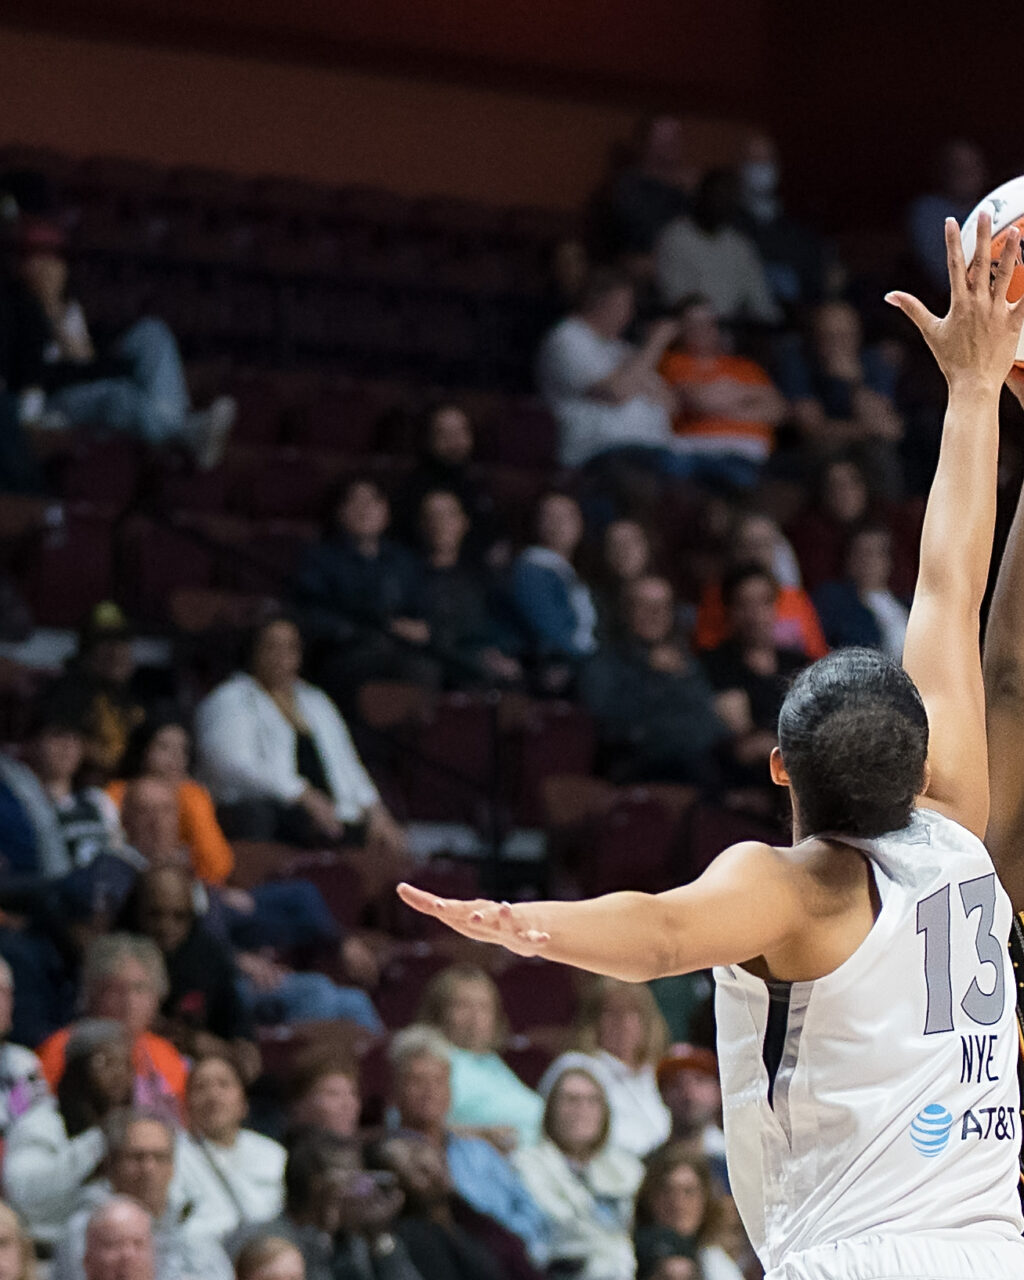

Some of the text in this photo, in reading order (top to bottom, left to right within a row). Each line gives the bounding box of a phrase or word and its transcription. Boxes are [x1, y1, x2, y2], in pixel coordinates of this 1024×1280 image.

[916, 872, 1005, 1035] 13
[960, 1034, 999, 1084] NYE
[961, 1106, 1015, 1140] AT&T
